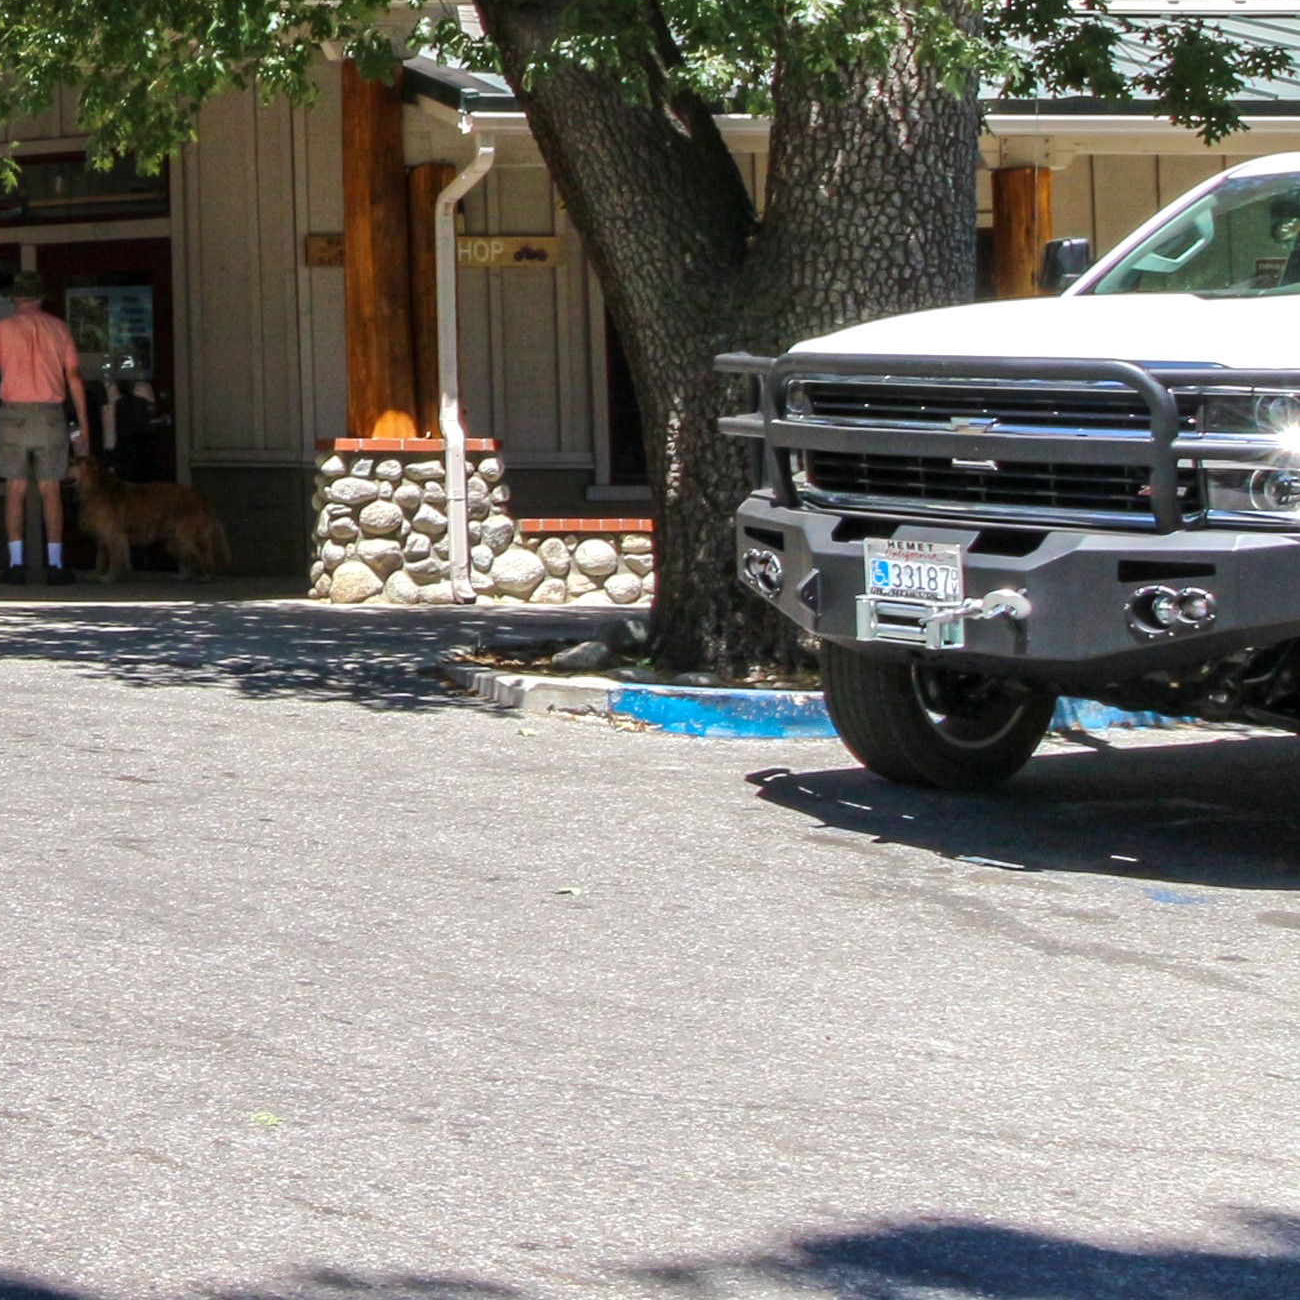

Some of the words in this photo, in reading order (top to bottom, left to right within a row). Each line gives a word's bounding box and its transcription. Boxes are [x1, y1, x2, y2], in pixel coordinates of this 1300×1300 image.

[457, 240, 504, 262] HOP
[887, 540, 934, 552] HEMET
[891, 563, 950, 595] 33187
